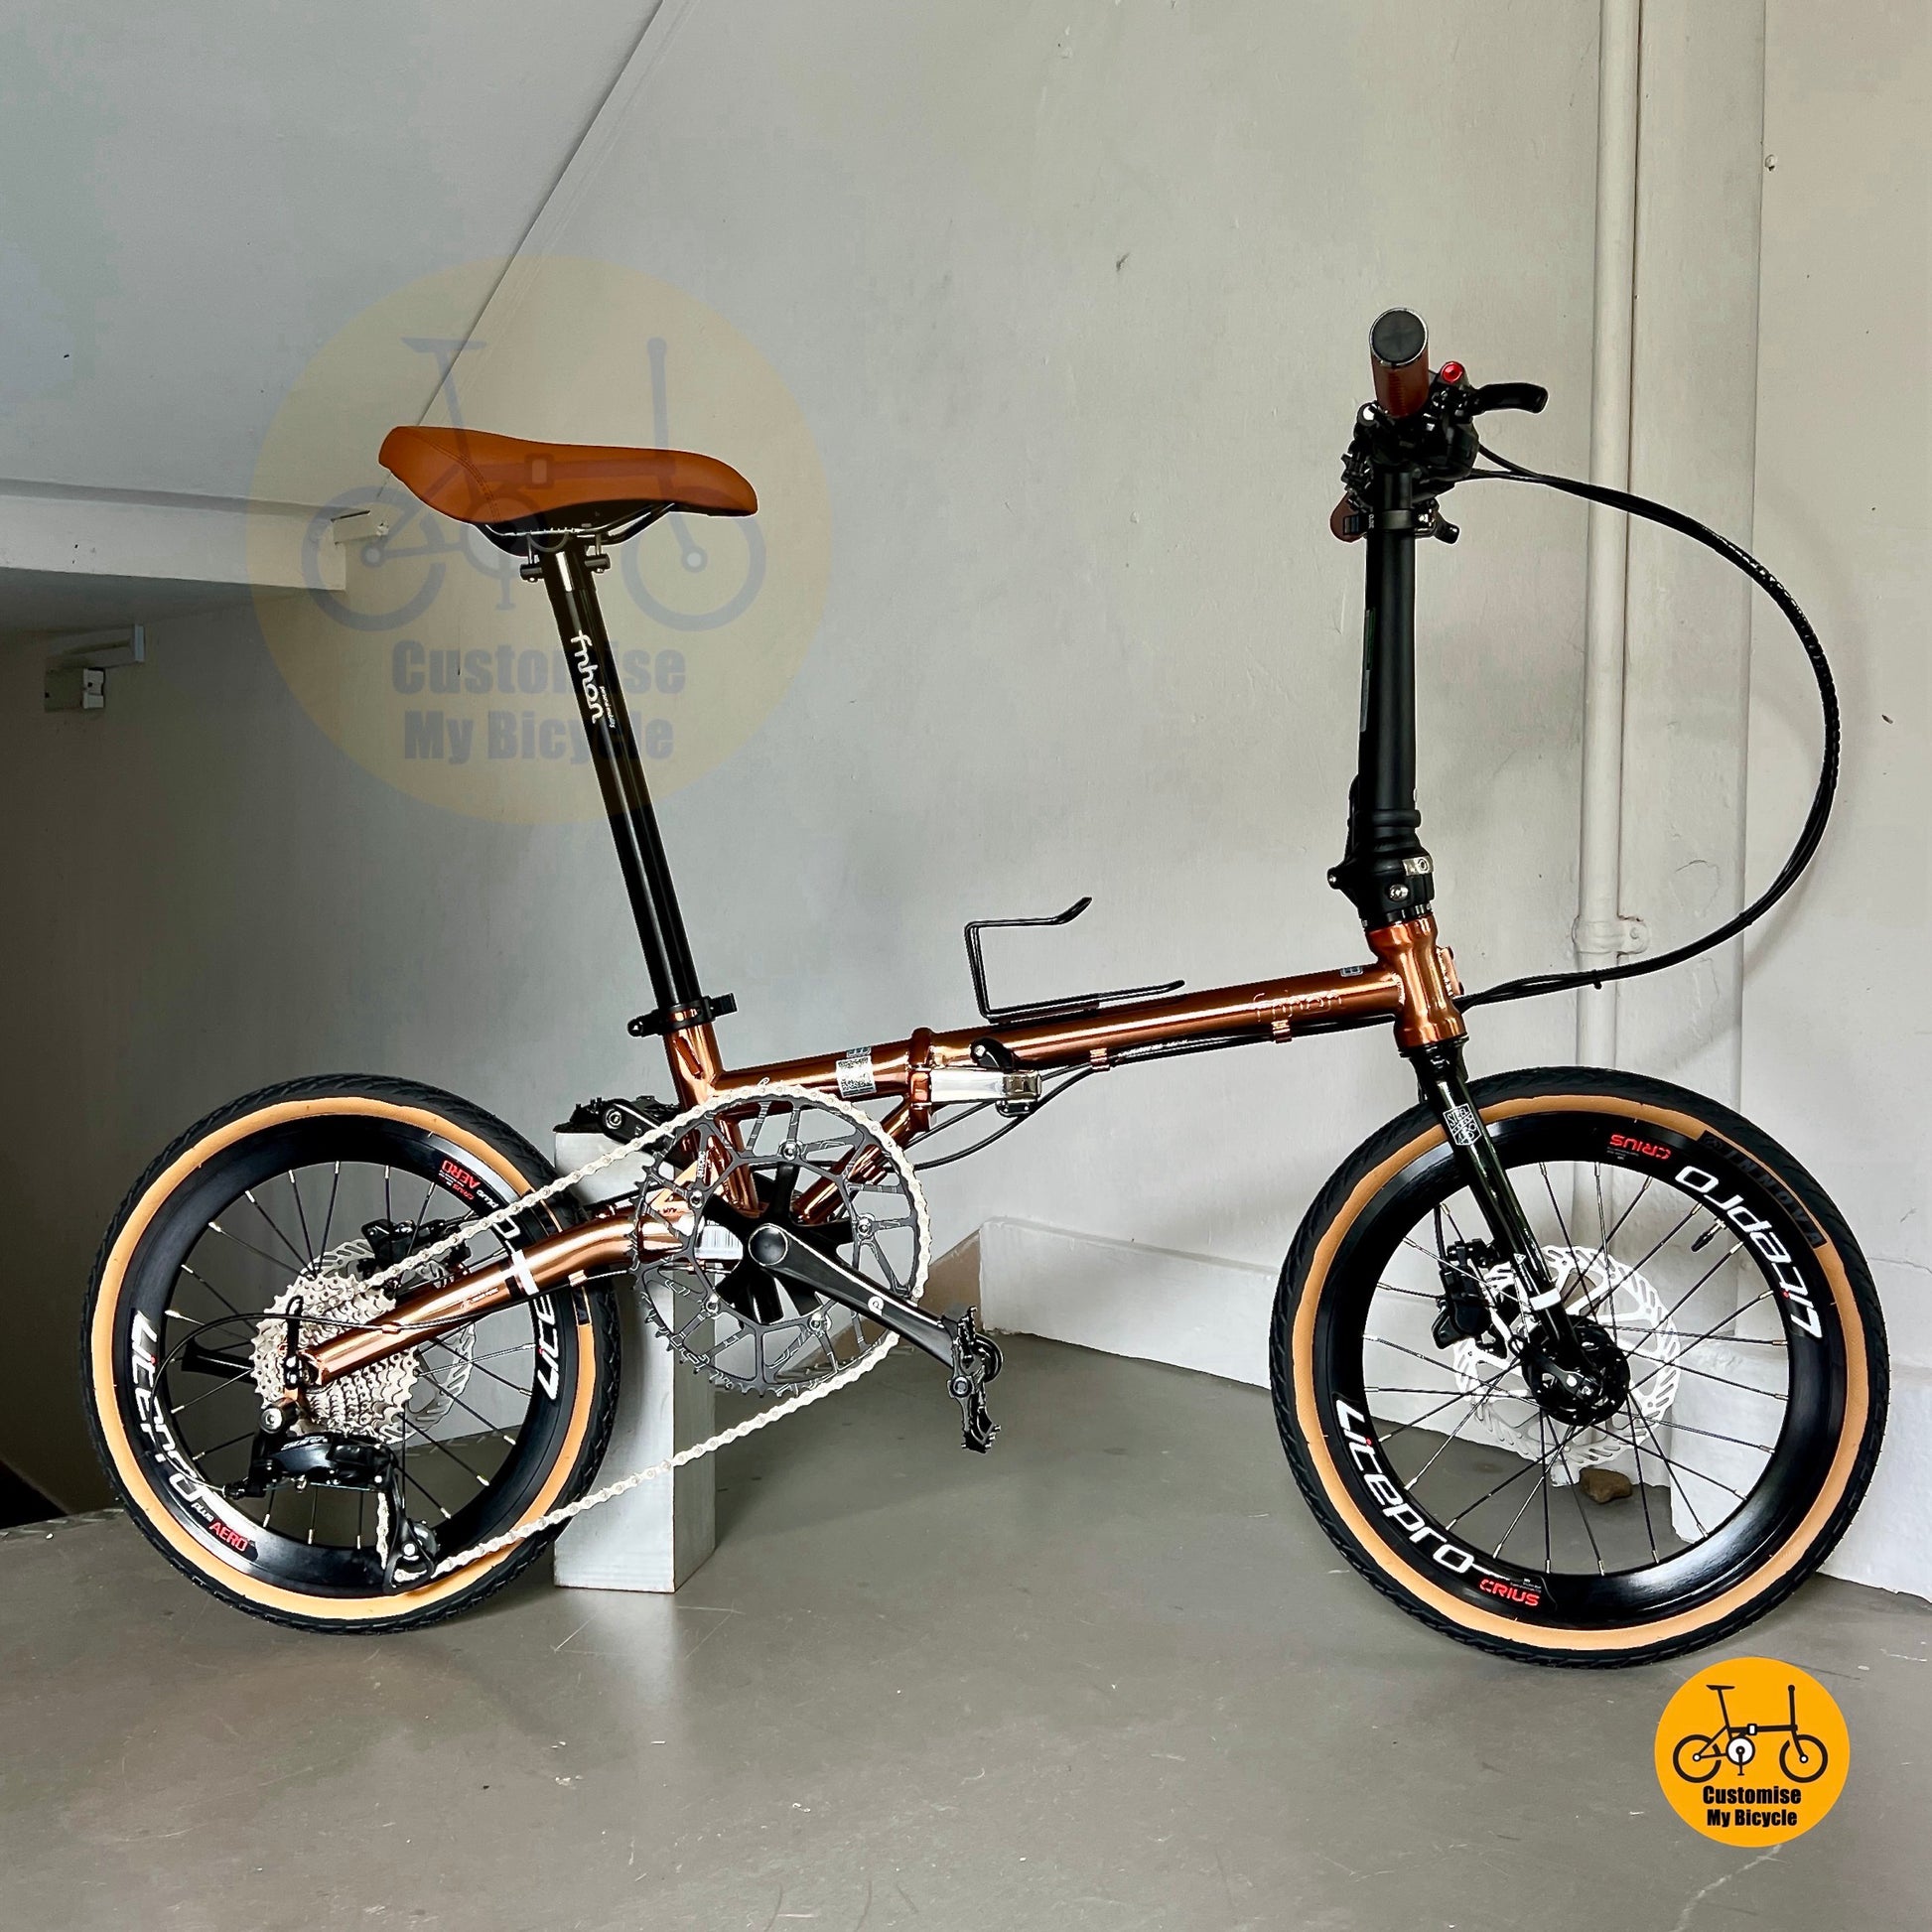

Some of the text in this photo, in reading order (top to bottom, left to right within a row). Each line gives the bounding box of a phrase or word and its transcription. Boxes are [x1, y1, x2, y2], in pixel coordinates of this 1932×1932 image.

[571, 629, 604, 725] fnhon
[443, 1160, 481, 1190] AERO
[1609, 1134, 1672, 1161] CRIUS
[1723, 1146, 1822, 1243] INNOVA
[1675, 1166, 1823, 1338] Litepro
[1336, 1399, 1475, 1574] Litepro
[192, 1501, 249, 1552] plus AERO
[1479, 1578, 1541, 1606] CRIUS
